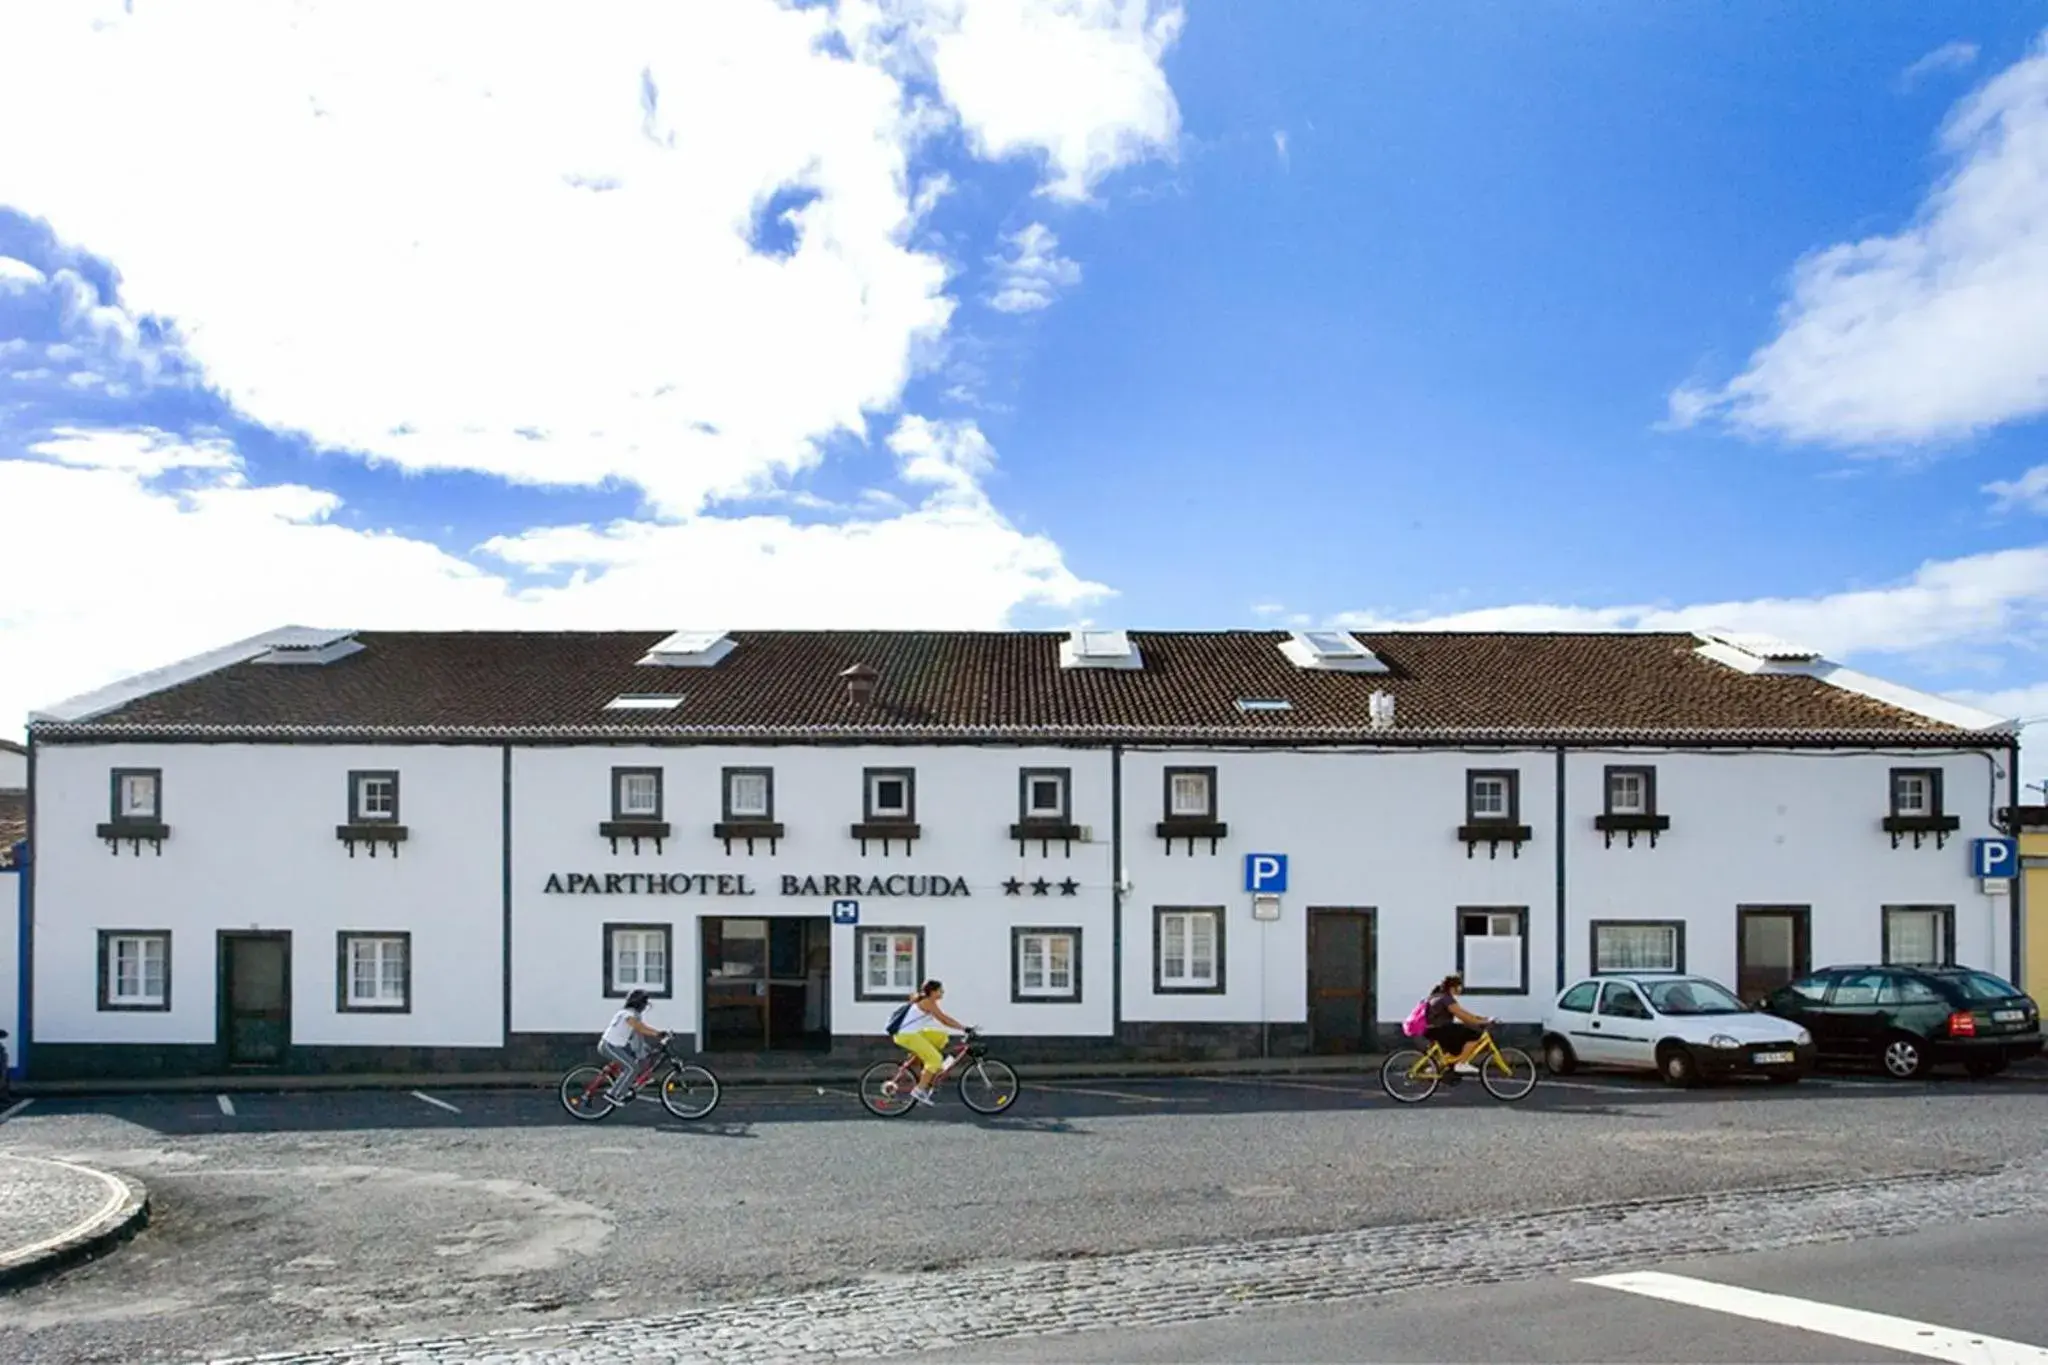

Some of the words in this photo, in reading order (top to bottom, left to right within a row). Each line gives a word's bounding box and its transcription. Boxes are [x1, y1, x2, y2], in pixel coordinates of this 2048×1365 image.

[1983, 842, 2008, 874] P
[543, 872, 756, 896] APARTHOTEL
[780, 874, 971, 897] BARRACUDA
[1253, 857, 1279, 889] P
[836, 902, 856, 918] H
